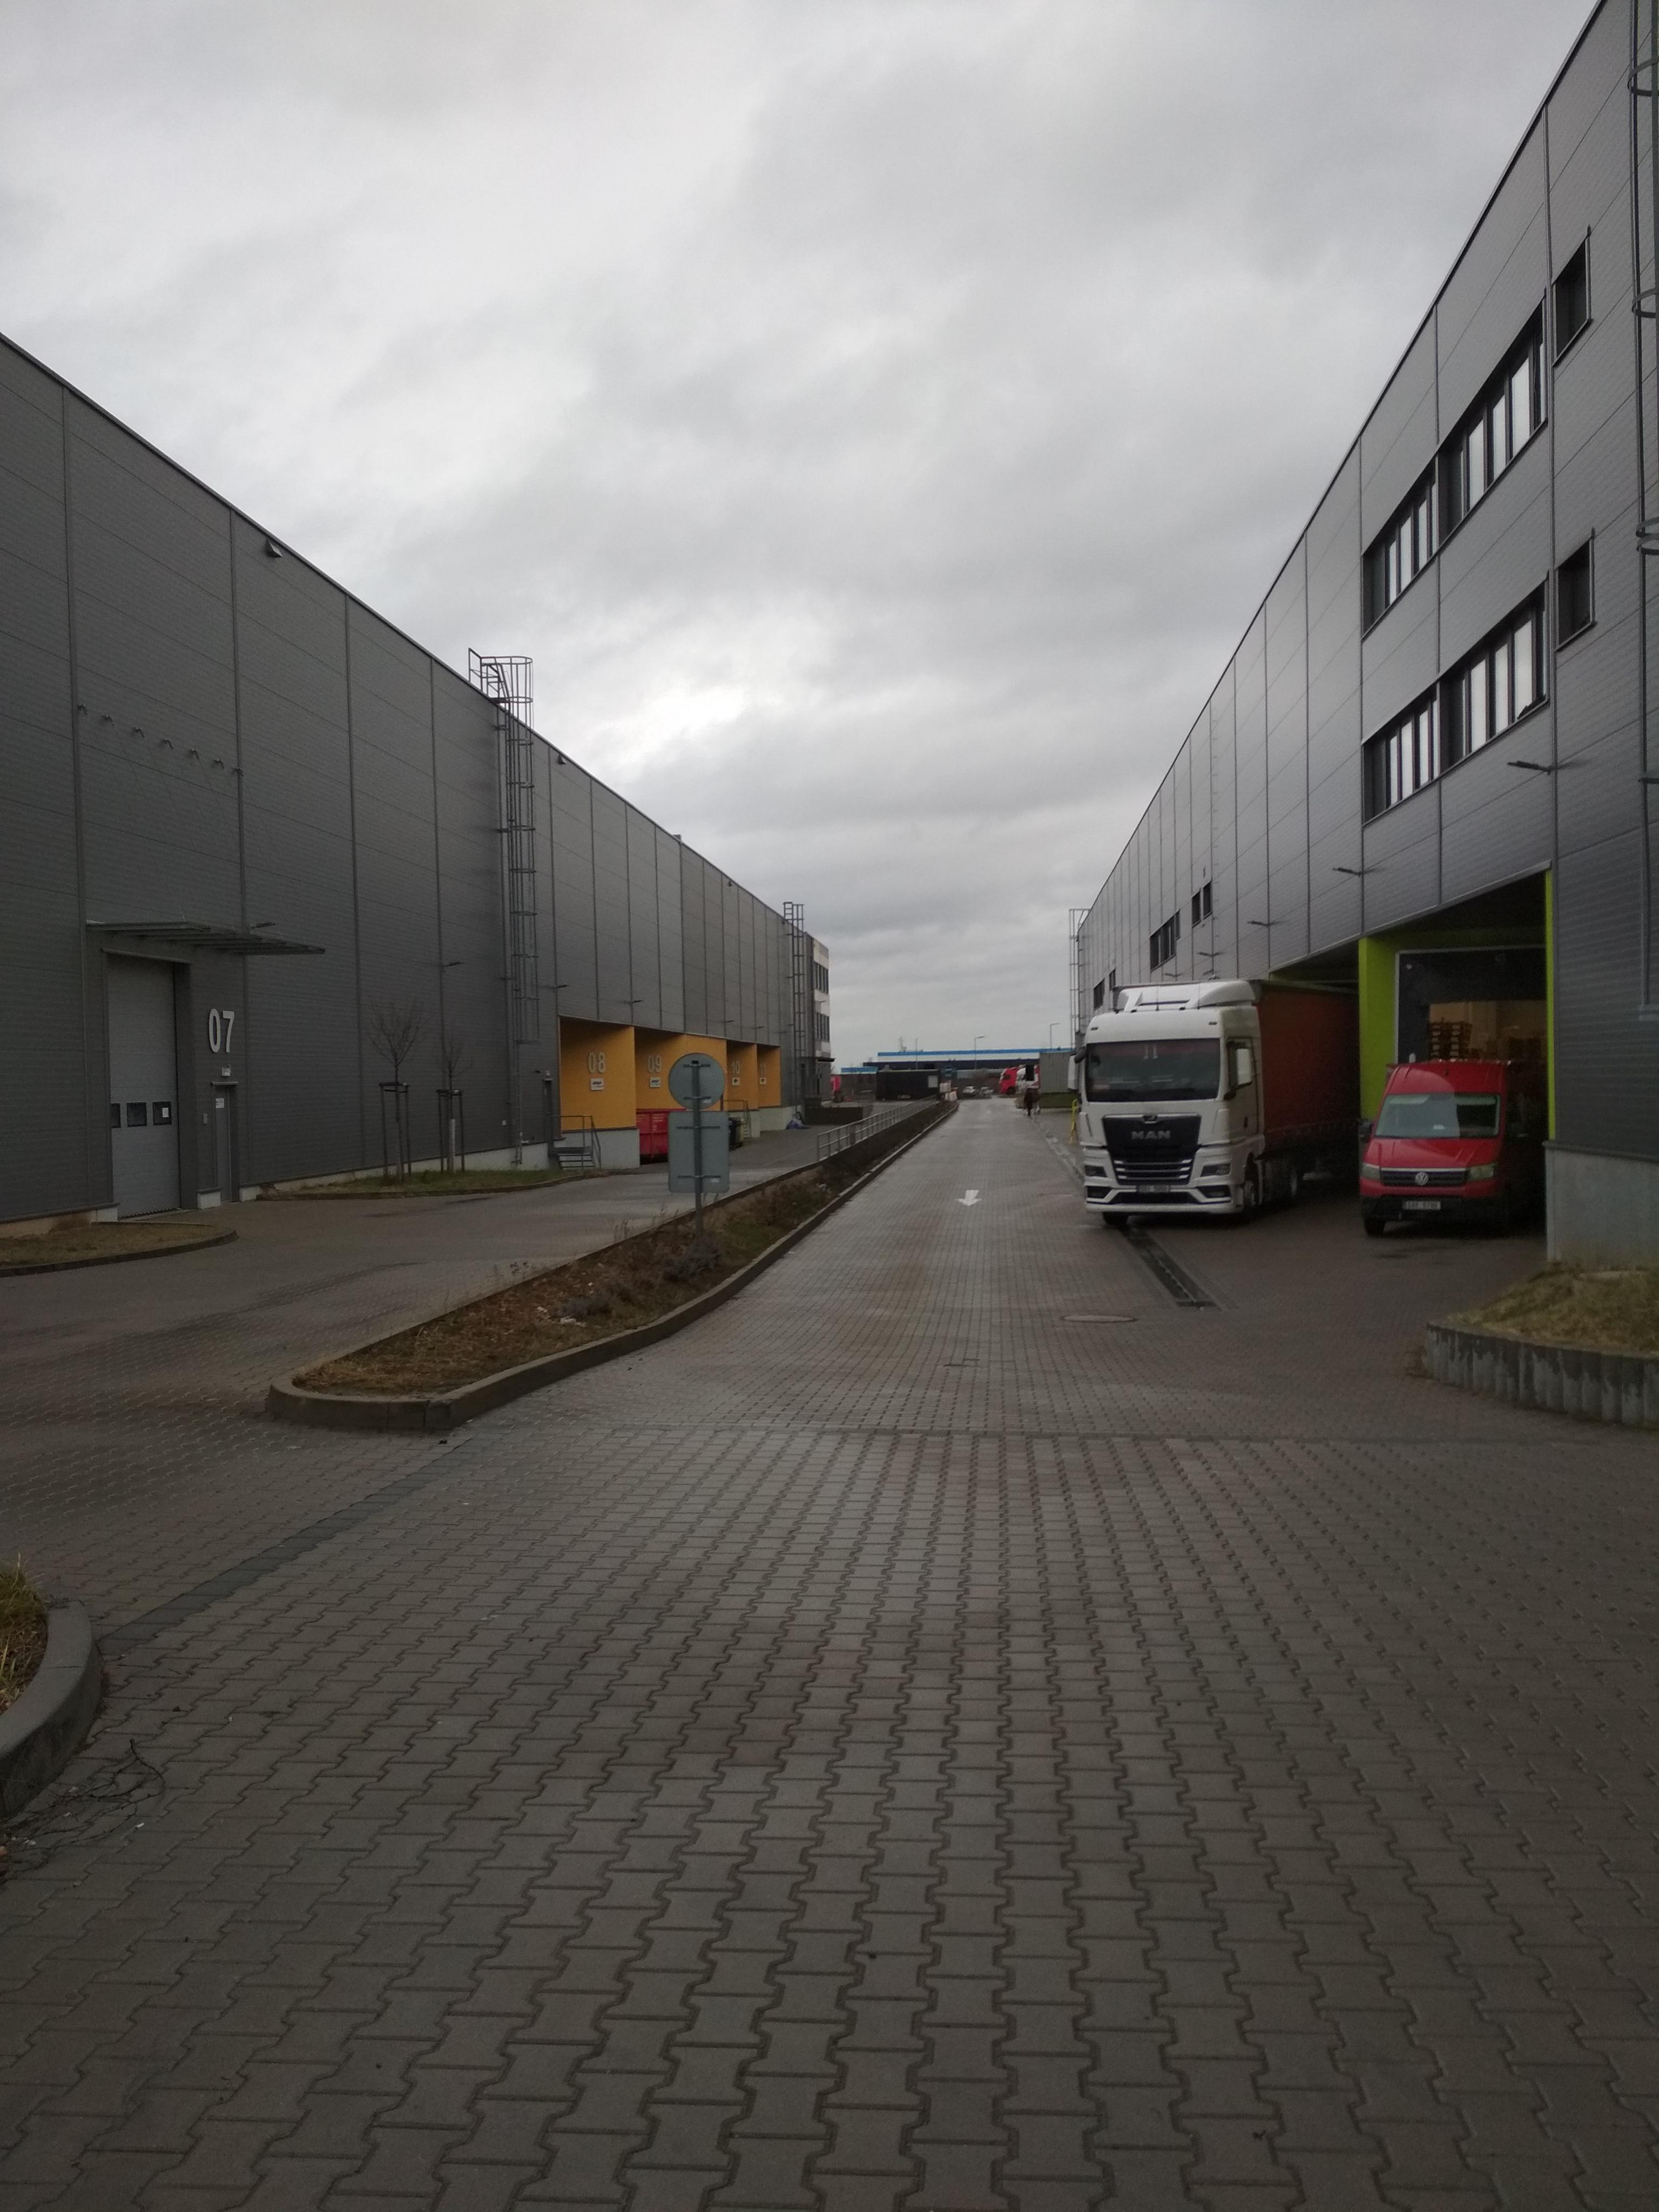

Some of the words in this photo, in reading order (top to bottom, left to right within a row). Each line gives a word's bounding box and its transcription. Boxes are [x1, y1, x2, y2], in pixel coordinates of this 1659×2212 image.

[209, 1008, 234, 1053] 07
[588, 1051, 605, 1073] 08
[648, 1055, 662, 1073] 09
[731, 1061, 740, 1075] 10
[1131, 1130, 1171, 1140] MAN
